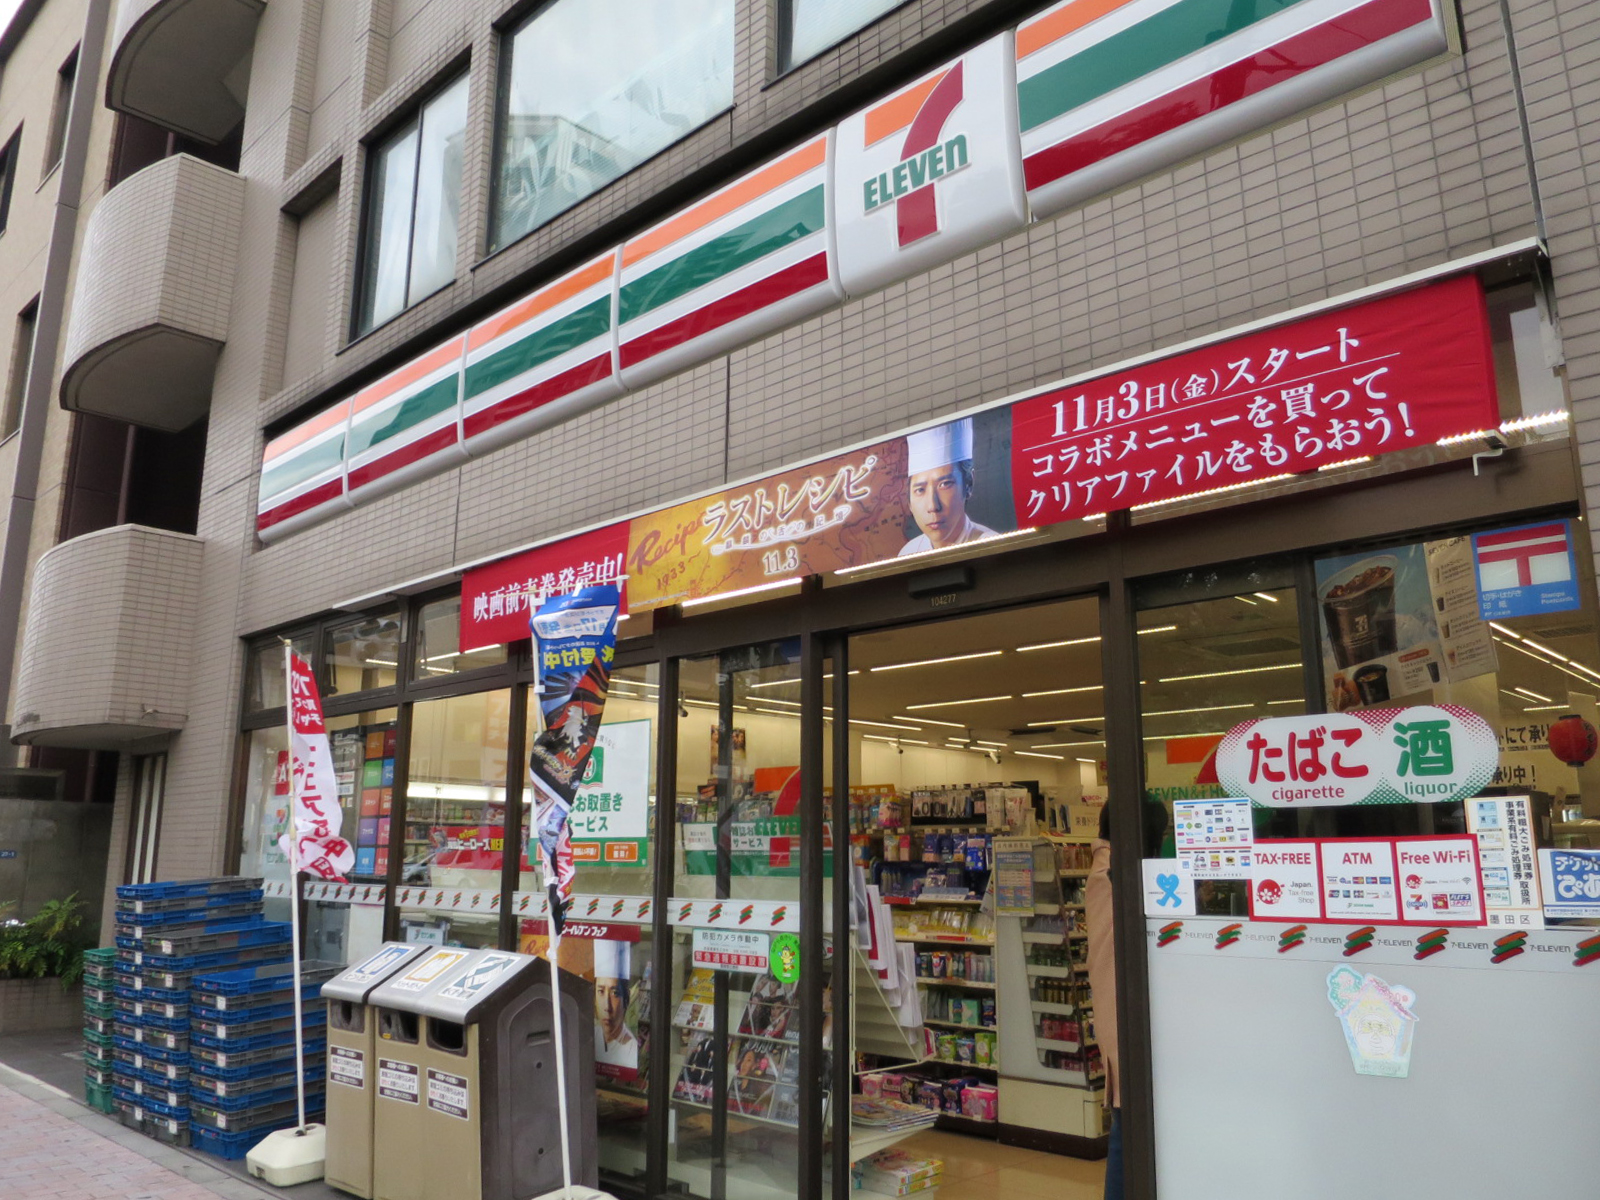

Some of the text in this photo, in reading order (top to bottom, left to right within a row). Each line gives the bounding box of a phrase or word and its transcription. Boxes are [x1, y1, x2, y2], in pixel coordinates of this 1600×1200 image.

[1031, 366, 1391, 479] コラボメニューを買って
[702, 455, 878, 545] ラストレシピ
[763, 546, 799, 575] 11.3
[930, 594, 957, 607] 104277
[1246, 725, 1369, 784] たばこ
[1393, 719, 1454, 777] 酒
[1272, 786, 1345, 802] cigarette
[1404, 780, 1457, 796] liquor
[1254, 852, 1311, 865] TAX-FREE
[1342, 852, 1373, 864] ATM
[1401, 850, 1471, 864] Free Wi-Fi
[1298, 897, 1315, 905] Shop
[702, 931, 759, 943] 防犯カメラ作動中
